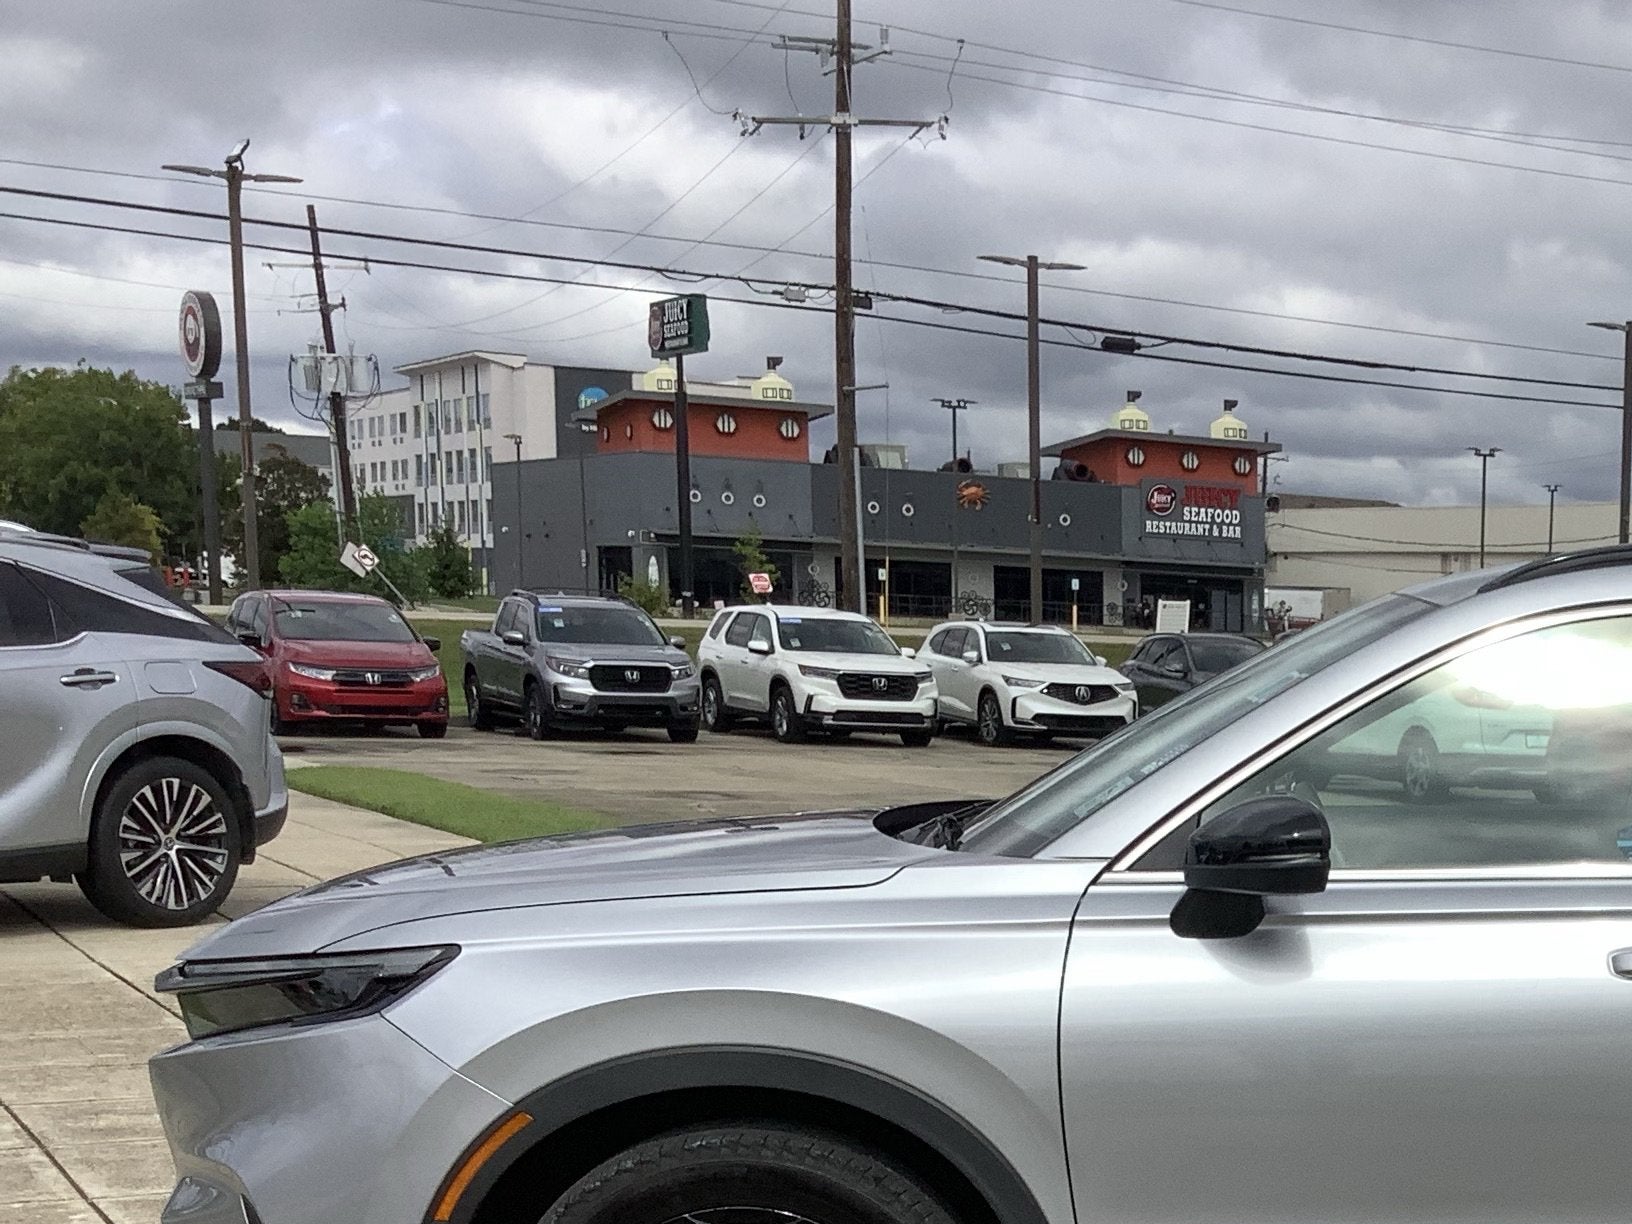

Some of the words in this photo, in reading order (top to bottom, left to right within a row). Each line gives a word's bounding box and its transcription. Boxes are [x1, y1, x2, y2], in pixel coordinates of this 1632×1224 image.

[664, 298, 688, 323] JUICY
[664, 320, 689, 338] SEAFOOD
[1183, 506, 1241, 524] SEAFOOD
[1145, 520, 1211, 537] RESTAURANT
[1212, 524, 1220, 537] &
[1221, 525, 1242, 538] BAR
